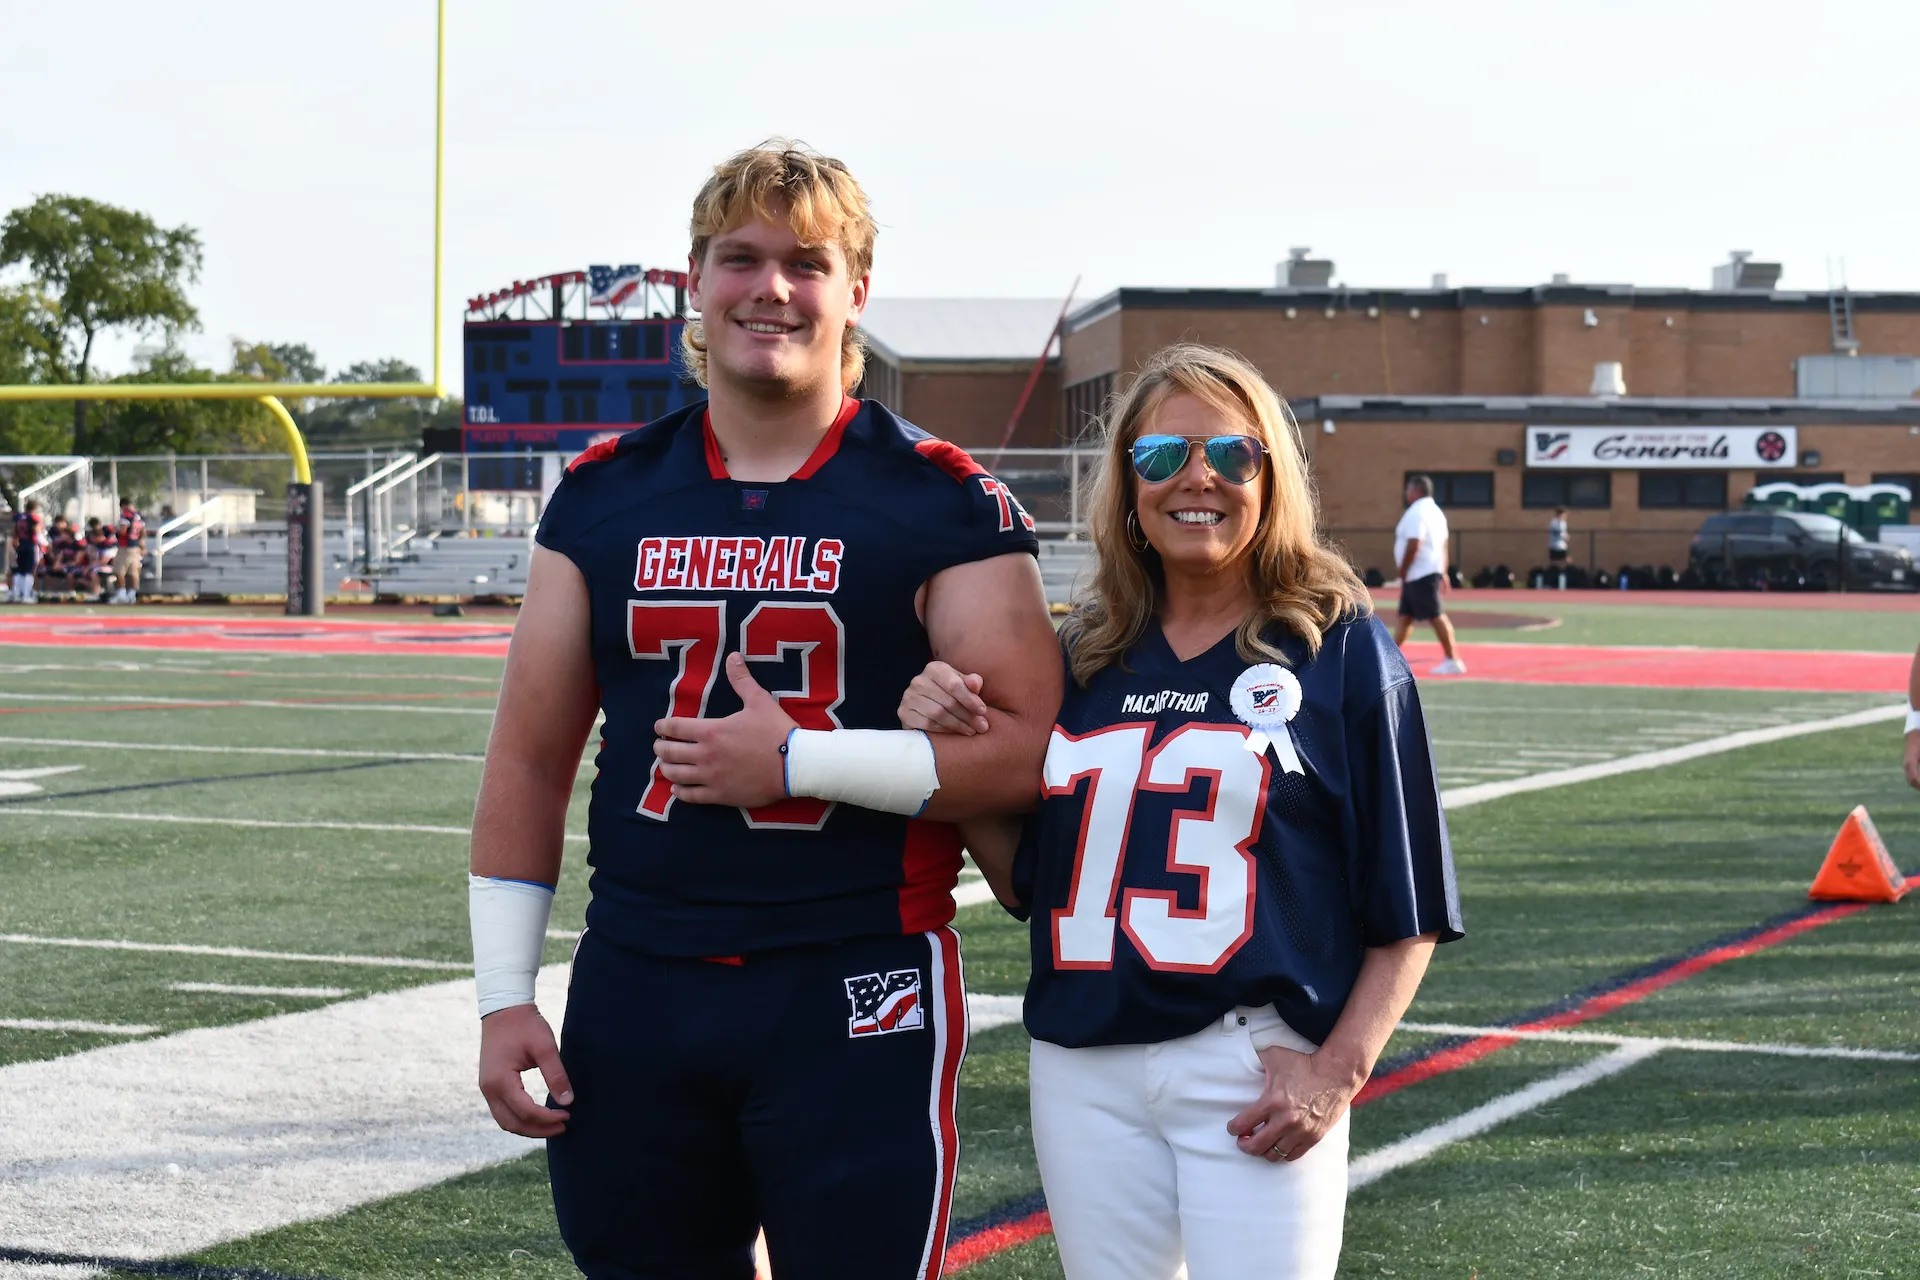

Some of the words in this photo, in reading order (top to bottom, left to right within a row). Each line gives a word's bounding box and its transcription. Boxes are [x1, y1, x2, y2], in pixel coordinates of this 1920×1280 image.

[1594, 435, 1729, 460] Generals
[633, 536, 845, 594] GENERALS
[627, 599, 846, 831] 73
[1121, 690, 1209, 714] MACARTHUR
[1040, 720, 1273, 974] 73
